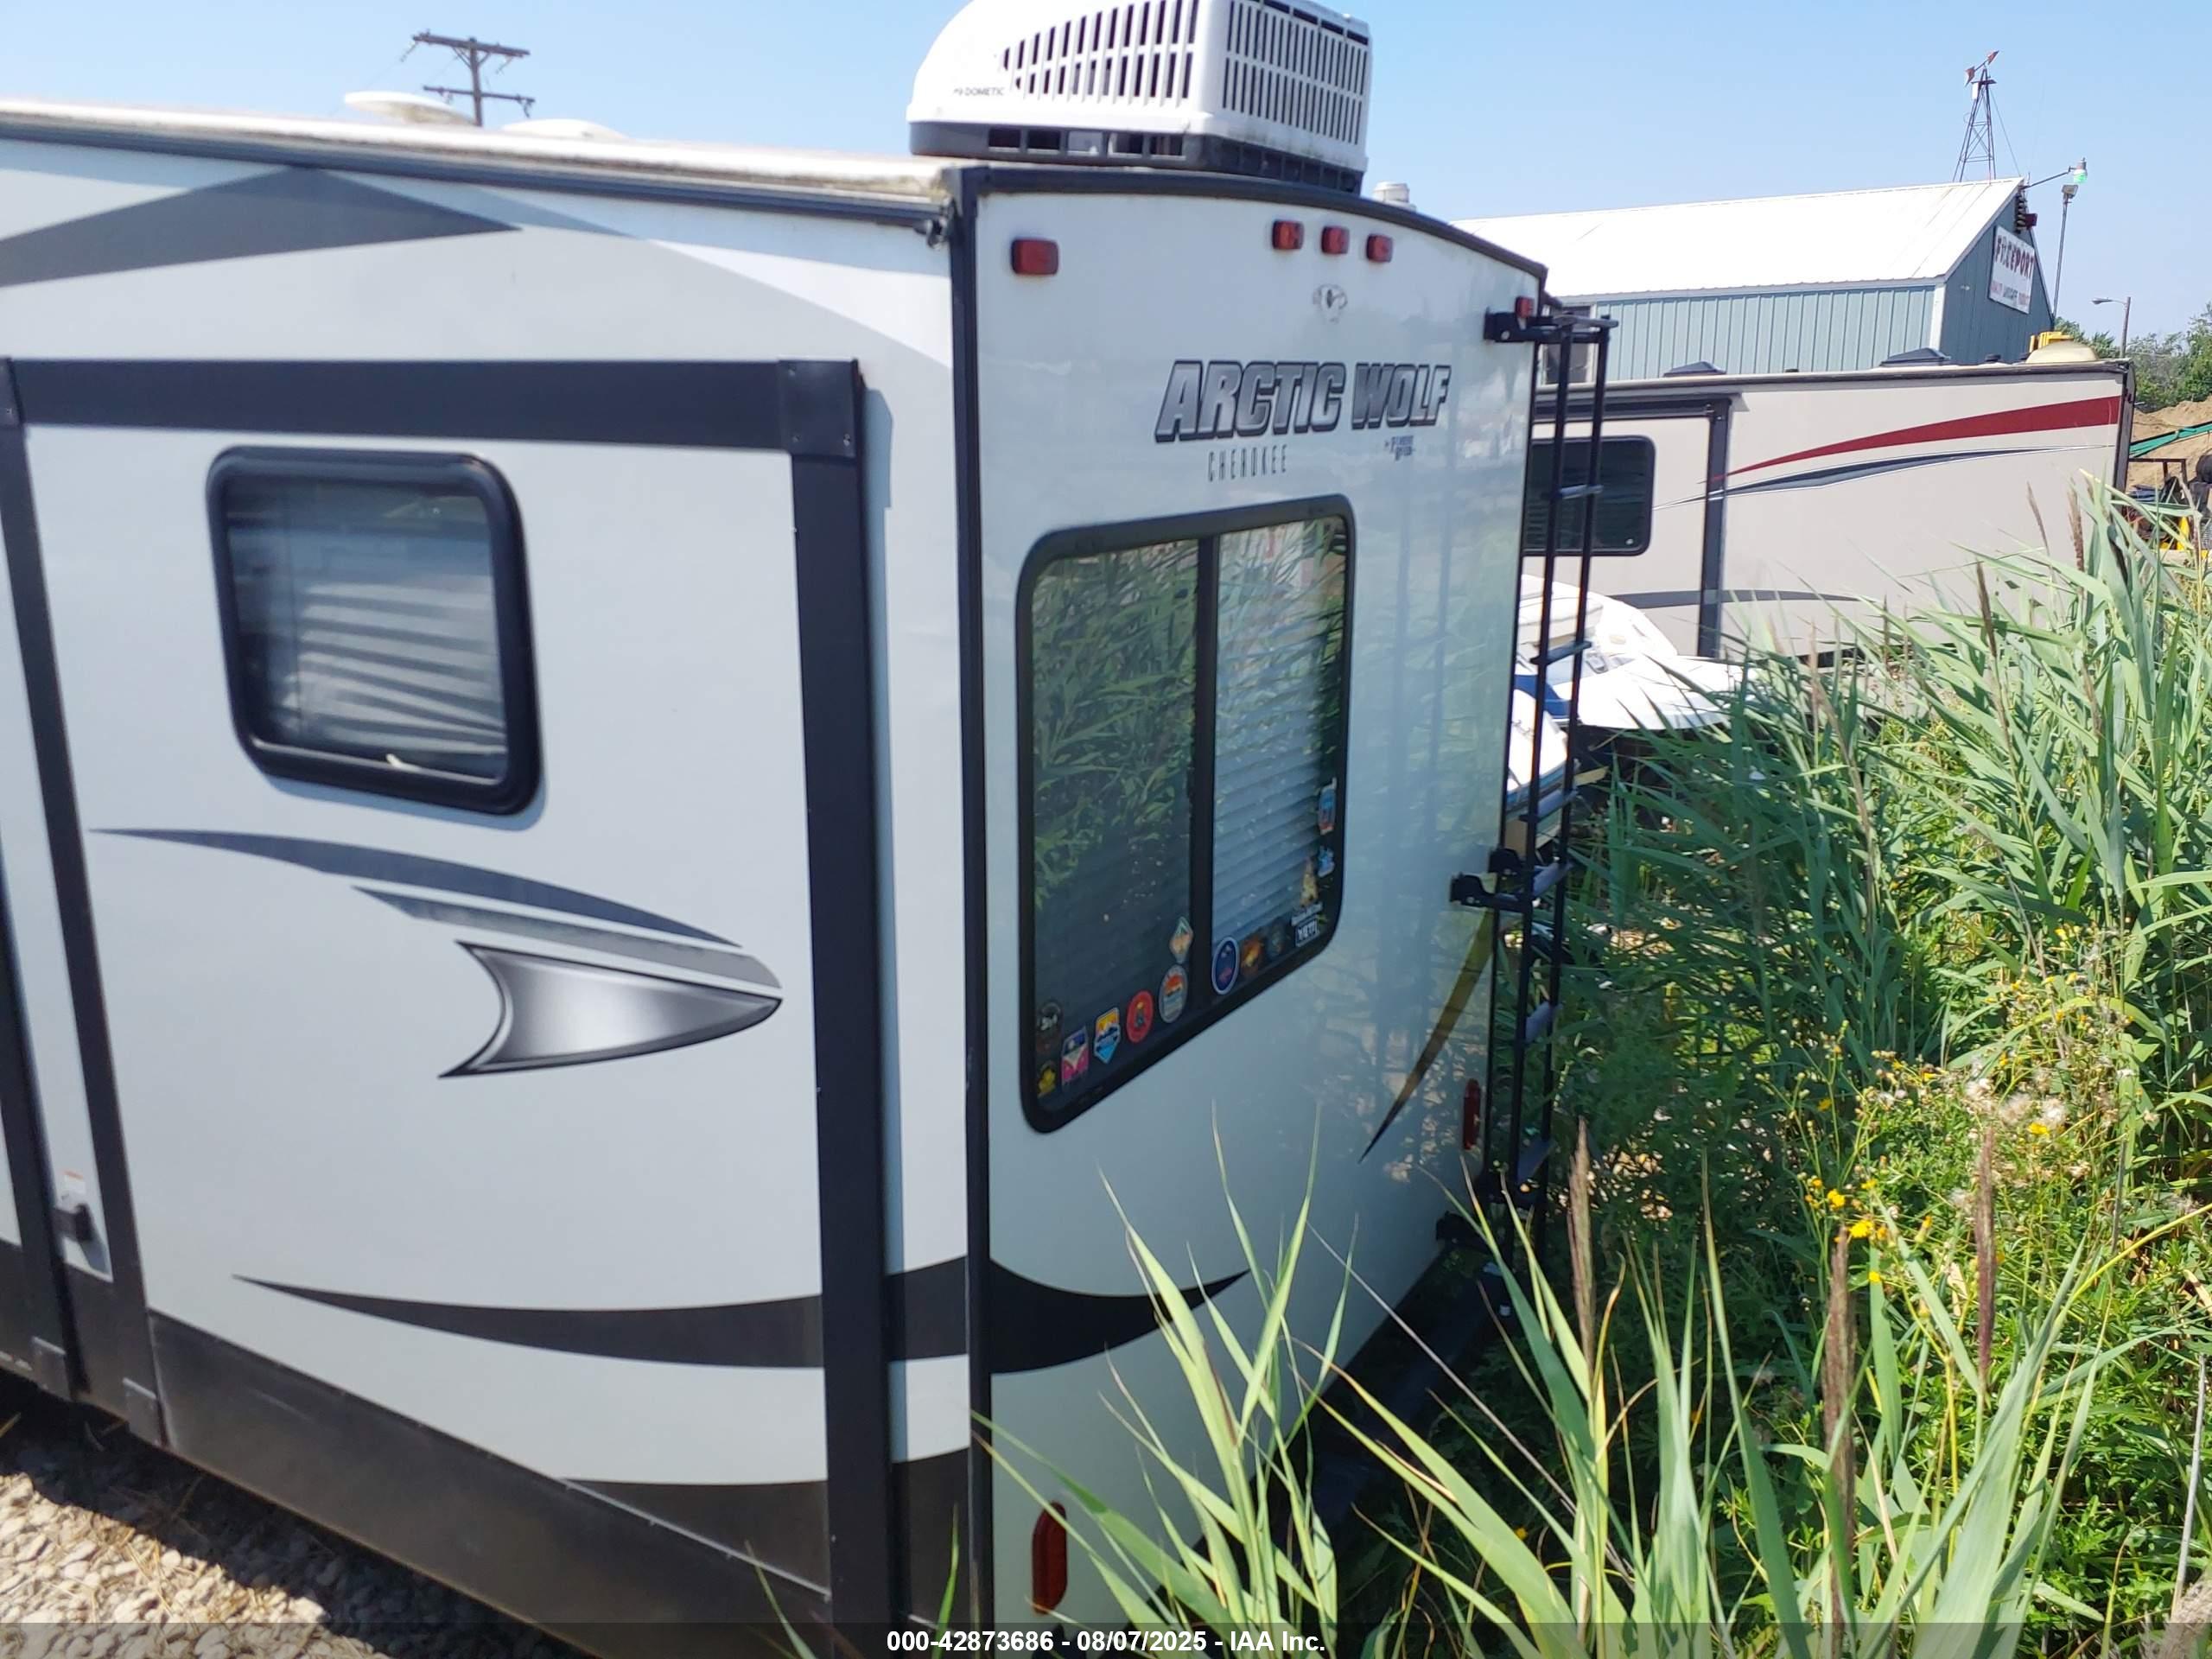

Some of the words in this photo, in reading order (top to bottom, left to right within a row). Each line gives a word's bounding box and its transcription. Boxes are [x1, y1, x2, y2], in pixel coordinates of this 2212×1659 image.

[1154, 360, 1346, 443] ARCTIC
[1351, 363, 1452, 429] WOLF
[1208, 443, 1287, 482] CHEROKEE
